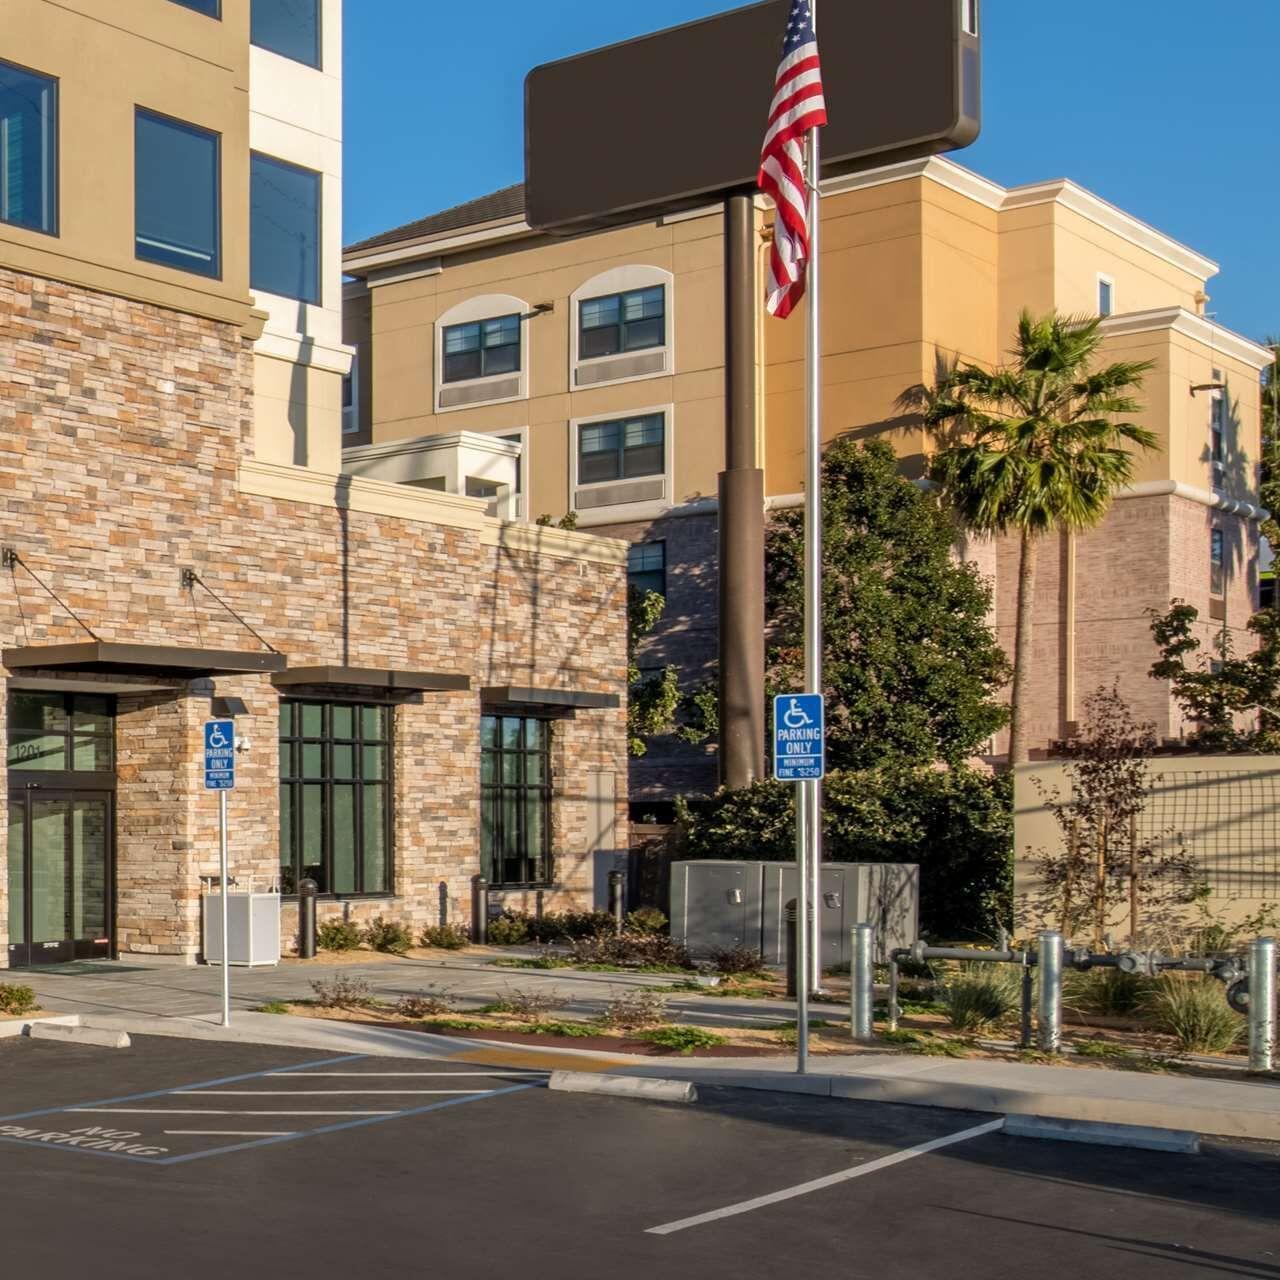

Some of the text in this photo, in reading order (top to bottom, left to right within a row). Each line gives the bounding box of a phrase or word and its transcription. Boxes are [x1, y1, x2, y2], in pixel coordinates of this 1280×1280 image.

[778, 728, 820, 741] PARKING
[206, 748, 233, 758] PARKING
[786, 742, 812, 754] ONLY
[211, 759, 228, 769] ONLY
[778, 768, 794, 777] FINE
[70, 1126, 141, 1139] NO
